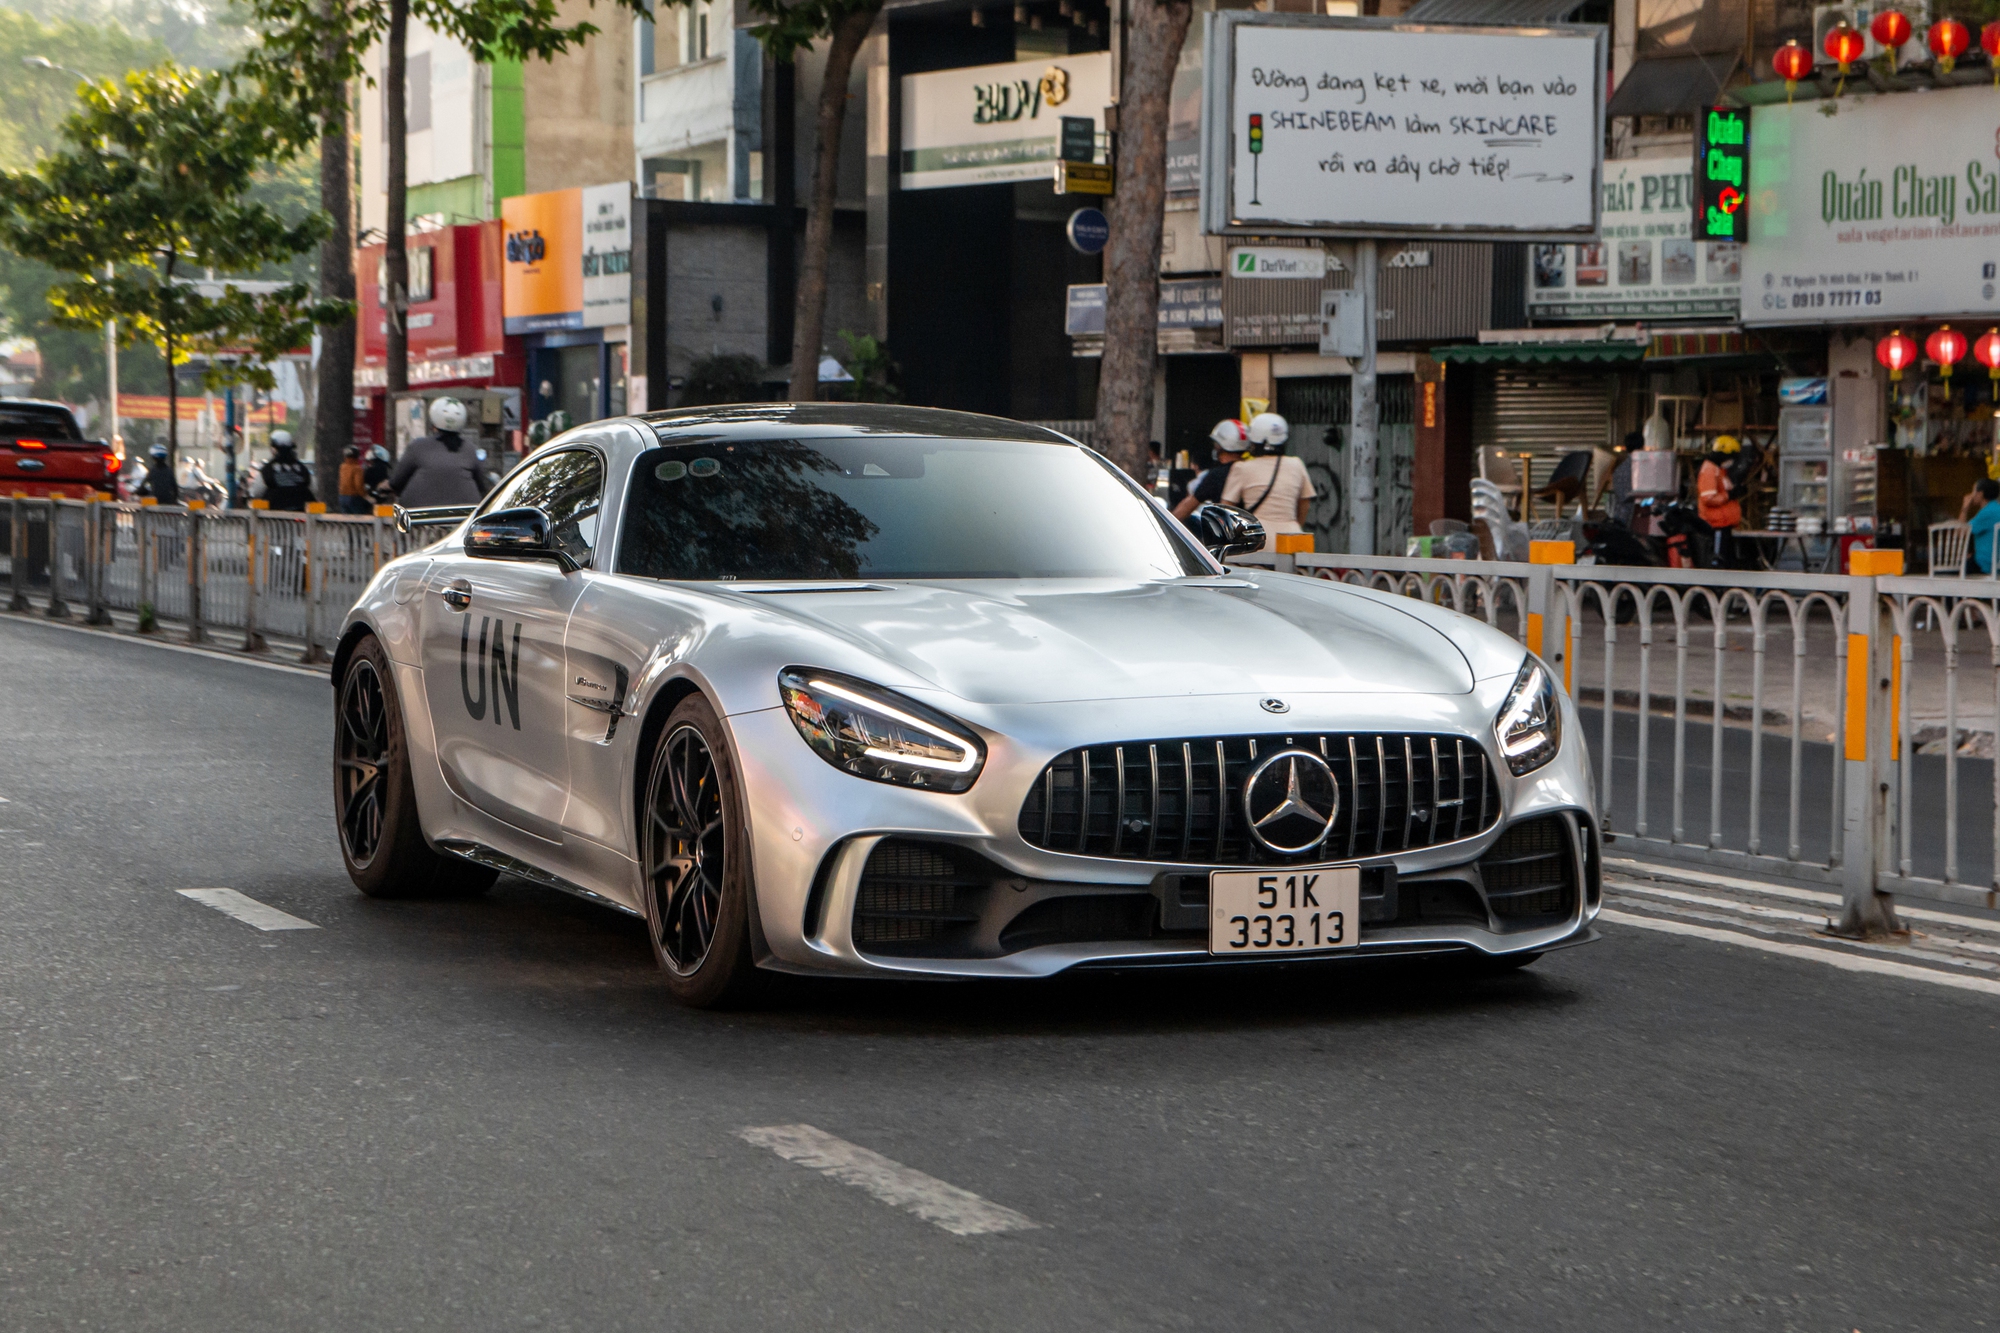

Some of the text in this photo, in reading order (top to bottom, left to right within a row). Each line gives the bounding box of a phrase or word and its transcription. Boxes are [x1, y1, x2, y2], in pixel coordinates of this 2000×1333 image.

[1252, 67, 1309, 103] Đường
[1317, 71, 1366, 104] đang
[1374, 72, 1411, 98] kẹt
[1420, 79, 1446, 97] xe,
[1497, 75, 1534, 100] bạn
[1543, 75, 1577, 96] vào
[1270, 110, 1557, 136] SHINEBEAM làm SKINCARE
[1353, 160, 1376, 174] ra
[1385, 154, 1420, 182] đây
[1428, 158, 1461, 176] chờ
[1707, 148, 1742, 187] Chay
[1822, 160, 2000, 229] Quán Chay Sa
[1837, 227, 1863, 244] sala
[1866, 226, 1933, 245] vegetarian
[1792, 290, 1882, 309] 0919 7777 03
[461, 613, 522, 731] UN
[1258, 874, 1320, 909] 51K
[1229, 910, 1344, 948] 333.13
